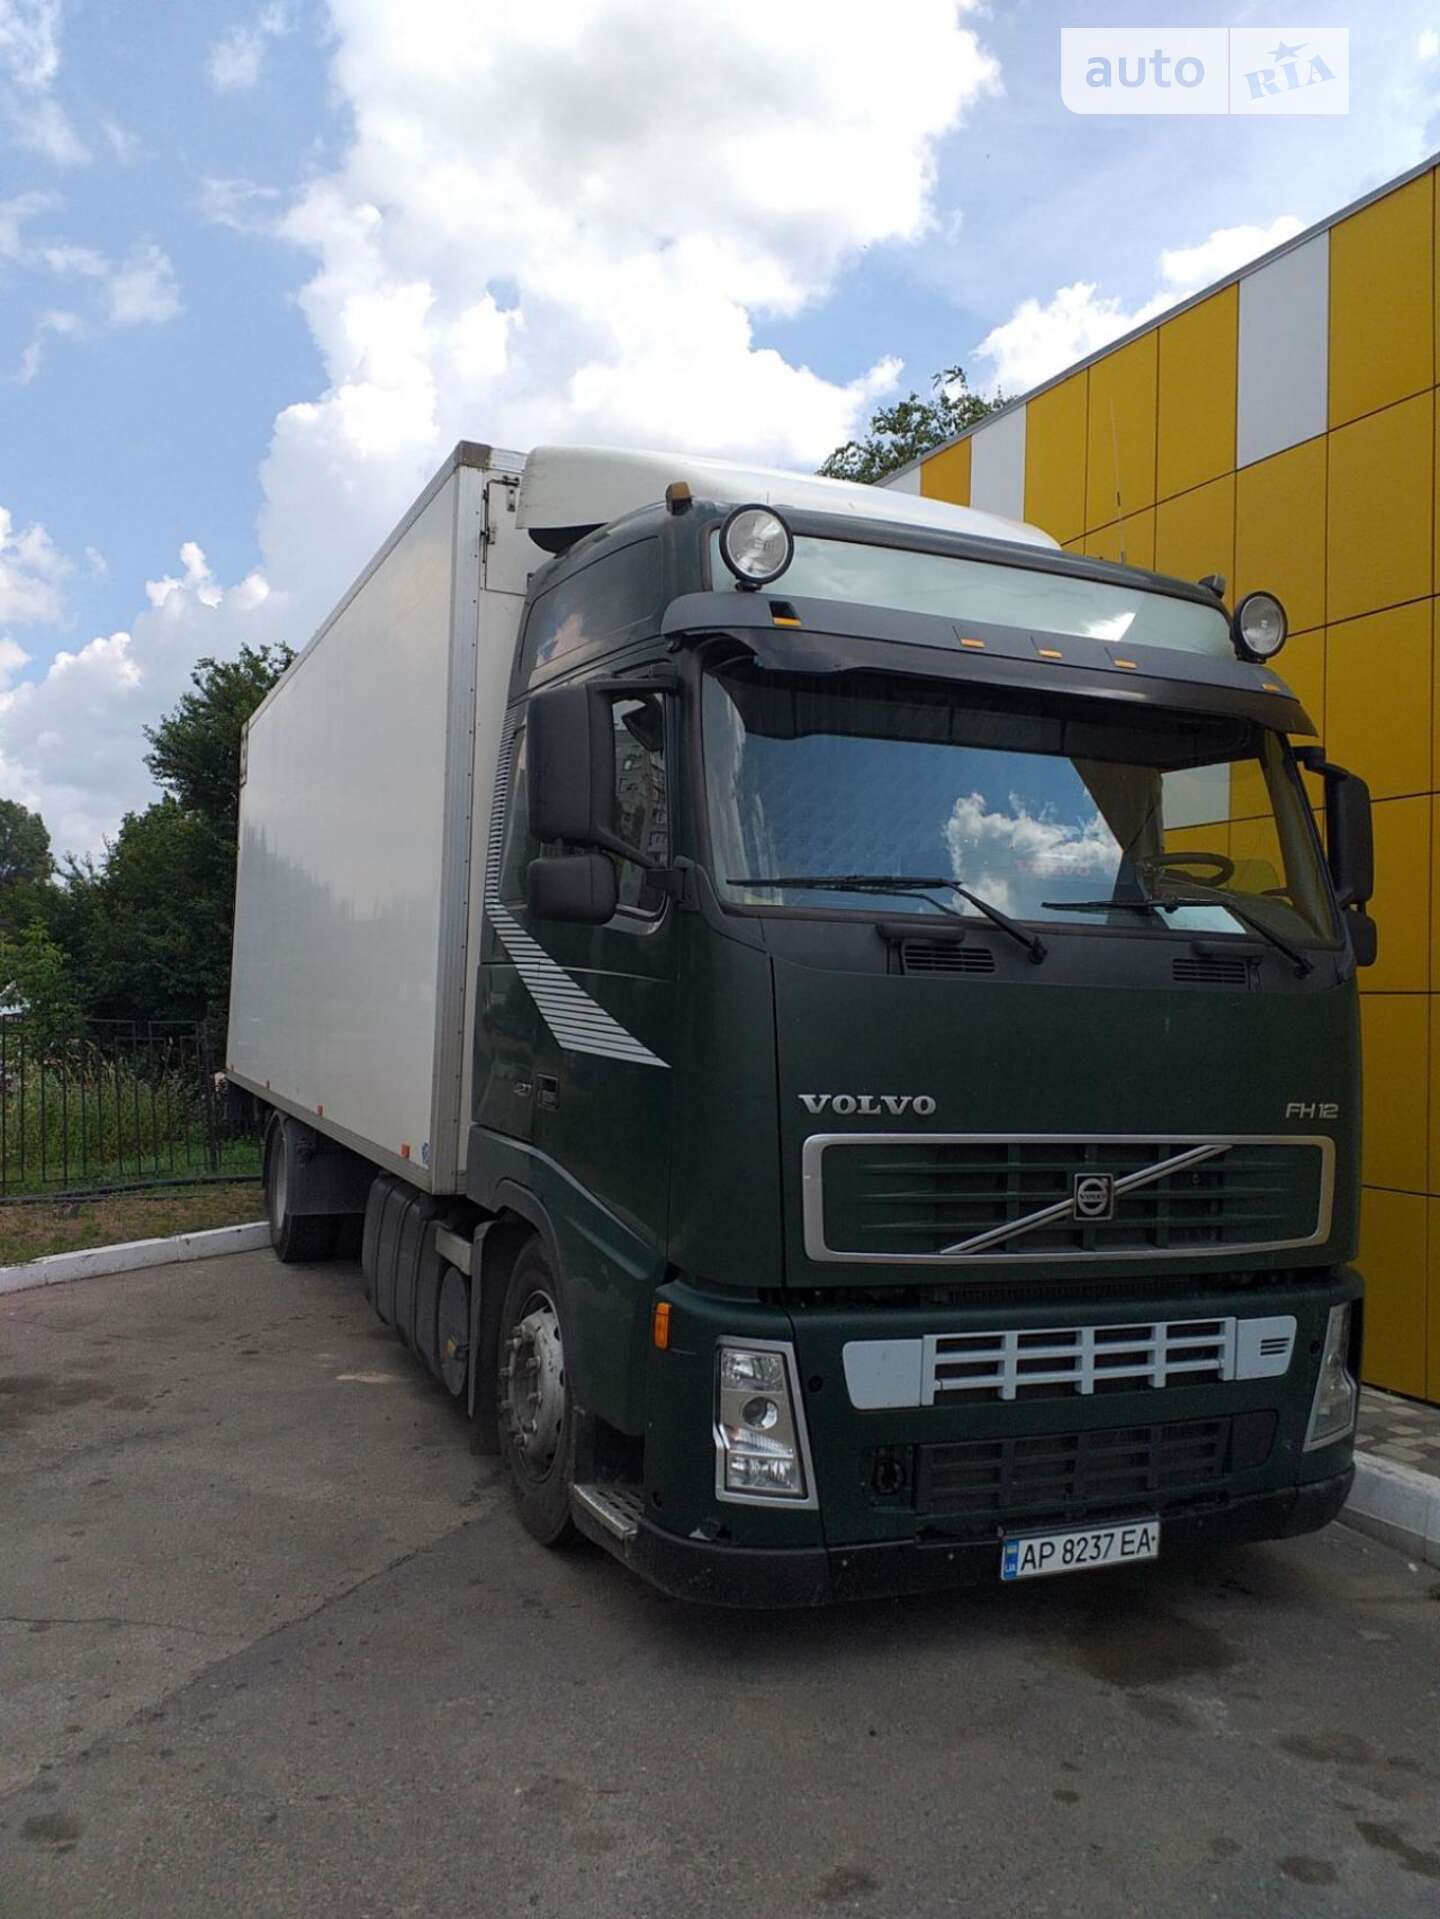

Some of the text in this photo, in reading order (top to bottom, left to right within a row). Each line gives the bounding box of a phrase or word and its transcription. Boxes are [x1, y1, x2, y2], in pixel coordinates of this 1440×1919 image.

[798, 1094, 936, 1115] VOLVO
[1020, 1527, 1151, 1571] AP 8237 EA
